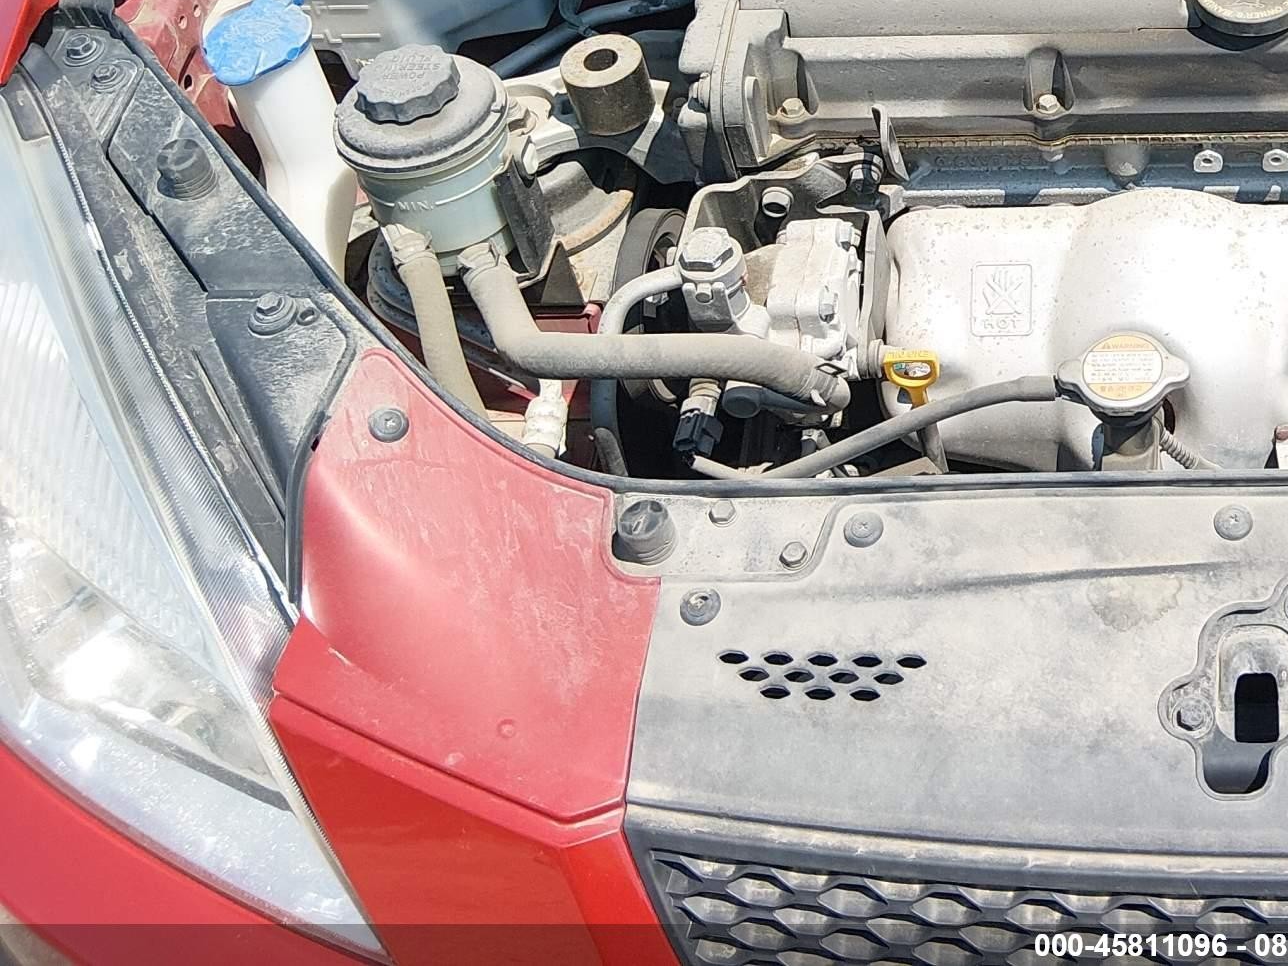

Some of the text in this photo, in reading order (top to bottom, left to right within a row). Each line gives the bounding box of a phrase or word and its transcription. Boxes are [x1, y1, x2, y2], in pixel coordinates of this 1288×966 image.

[383, 71, 426, 81] POWER
[397, 200, 435, 213] MIN.
[984, 315, 1024, 330] HOT
